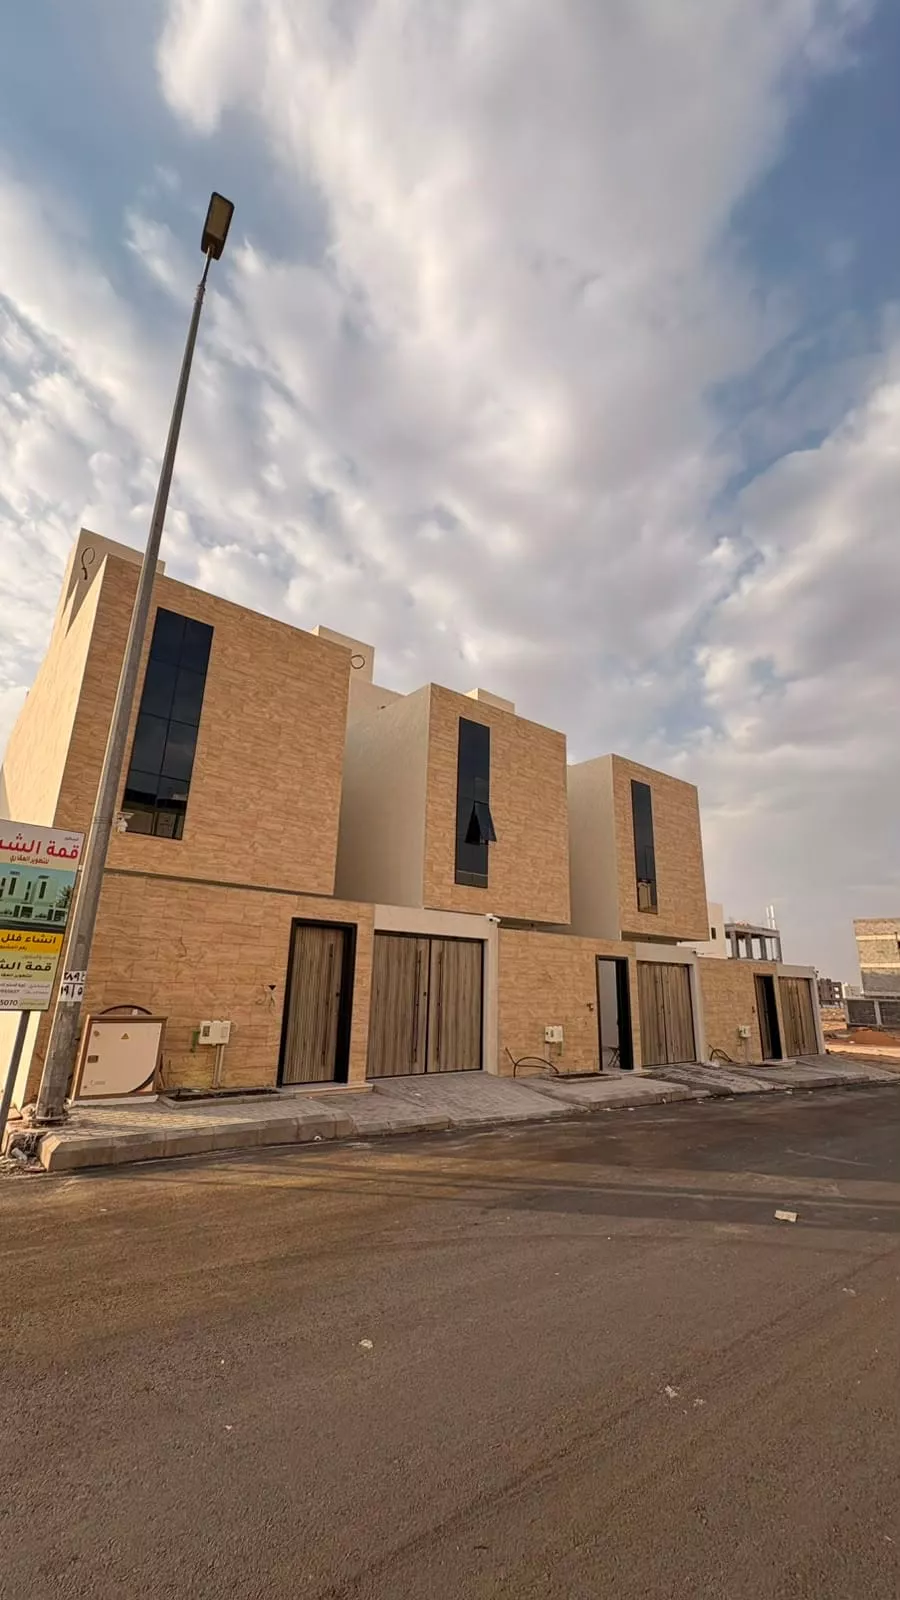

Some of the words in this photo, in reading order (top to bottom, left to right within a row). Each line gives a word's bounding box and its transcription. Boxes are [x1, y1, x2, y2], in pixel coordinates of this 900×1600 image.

[0, 833, 41, 854] الش
[47, 840, 79, 859] قمة
[1, 933, 22, 943] فلل
[0, 958, 21, 970] الش
[25, 961, 52, 971] قمة
